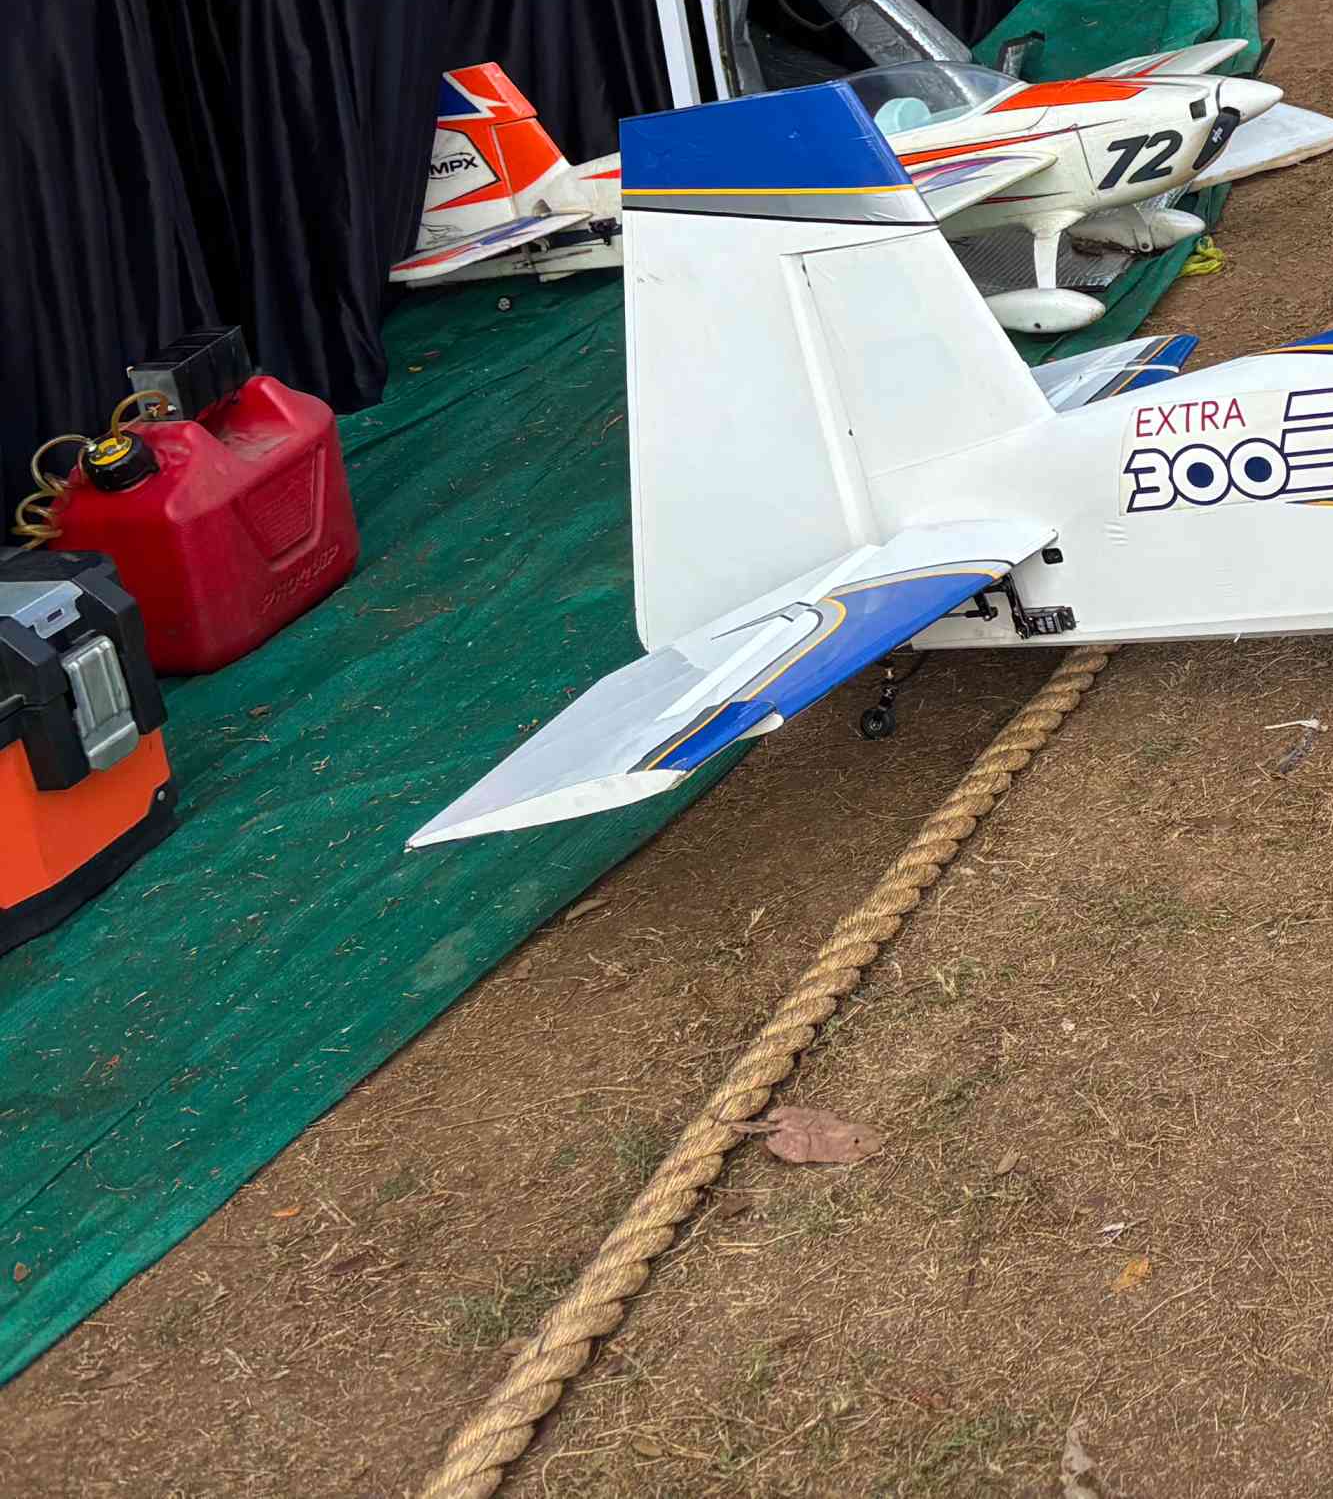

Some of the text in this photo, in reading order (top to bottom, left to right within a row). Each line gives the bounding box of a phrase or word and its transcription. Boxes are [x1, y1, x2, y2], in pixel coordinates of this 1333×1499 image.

[430, 156, 478, 176] MPX
[1097, 129, 1183, 191] 72
[1136, 398, 1246, 439] EXTRA
